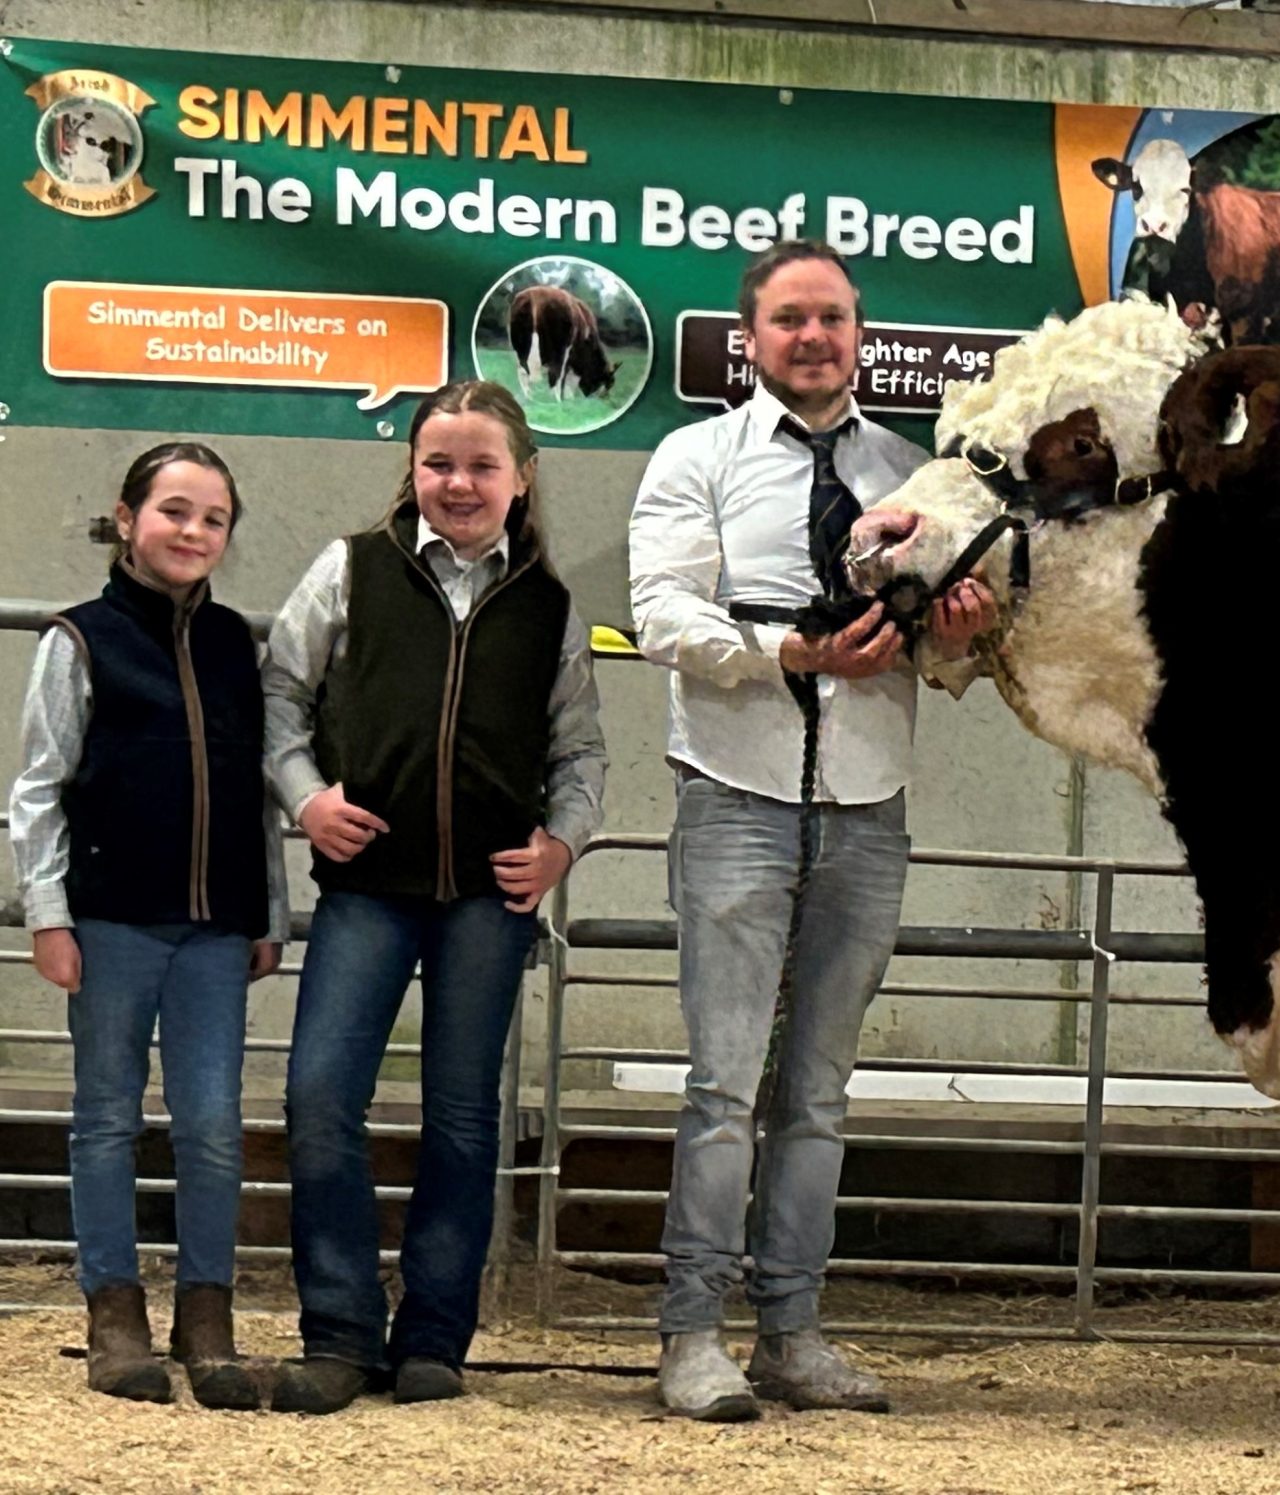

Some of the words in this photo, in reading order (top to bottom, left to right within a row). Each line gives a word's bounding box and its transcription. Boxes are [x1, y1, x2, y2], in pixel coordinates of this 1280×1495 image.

[178, 85, 588, 164] SIMMENTAL
[174, 157, 312, 223] The
[336, 167, 617, 244] Modern
[641, 186, 806, 252] Beef
[826, 195, 1035, 265] Breed
[87, 300, 226, 329] Simmental
[238, 307, 346, 335] Delivers
[356, 317, 388, 337] on
[145, 337, 329, 375] Sustainability
[859, 337, 933, 368] ghter
[943, 343, 991, 373] Age
[871, 368, 985, 397] Effici
